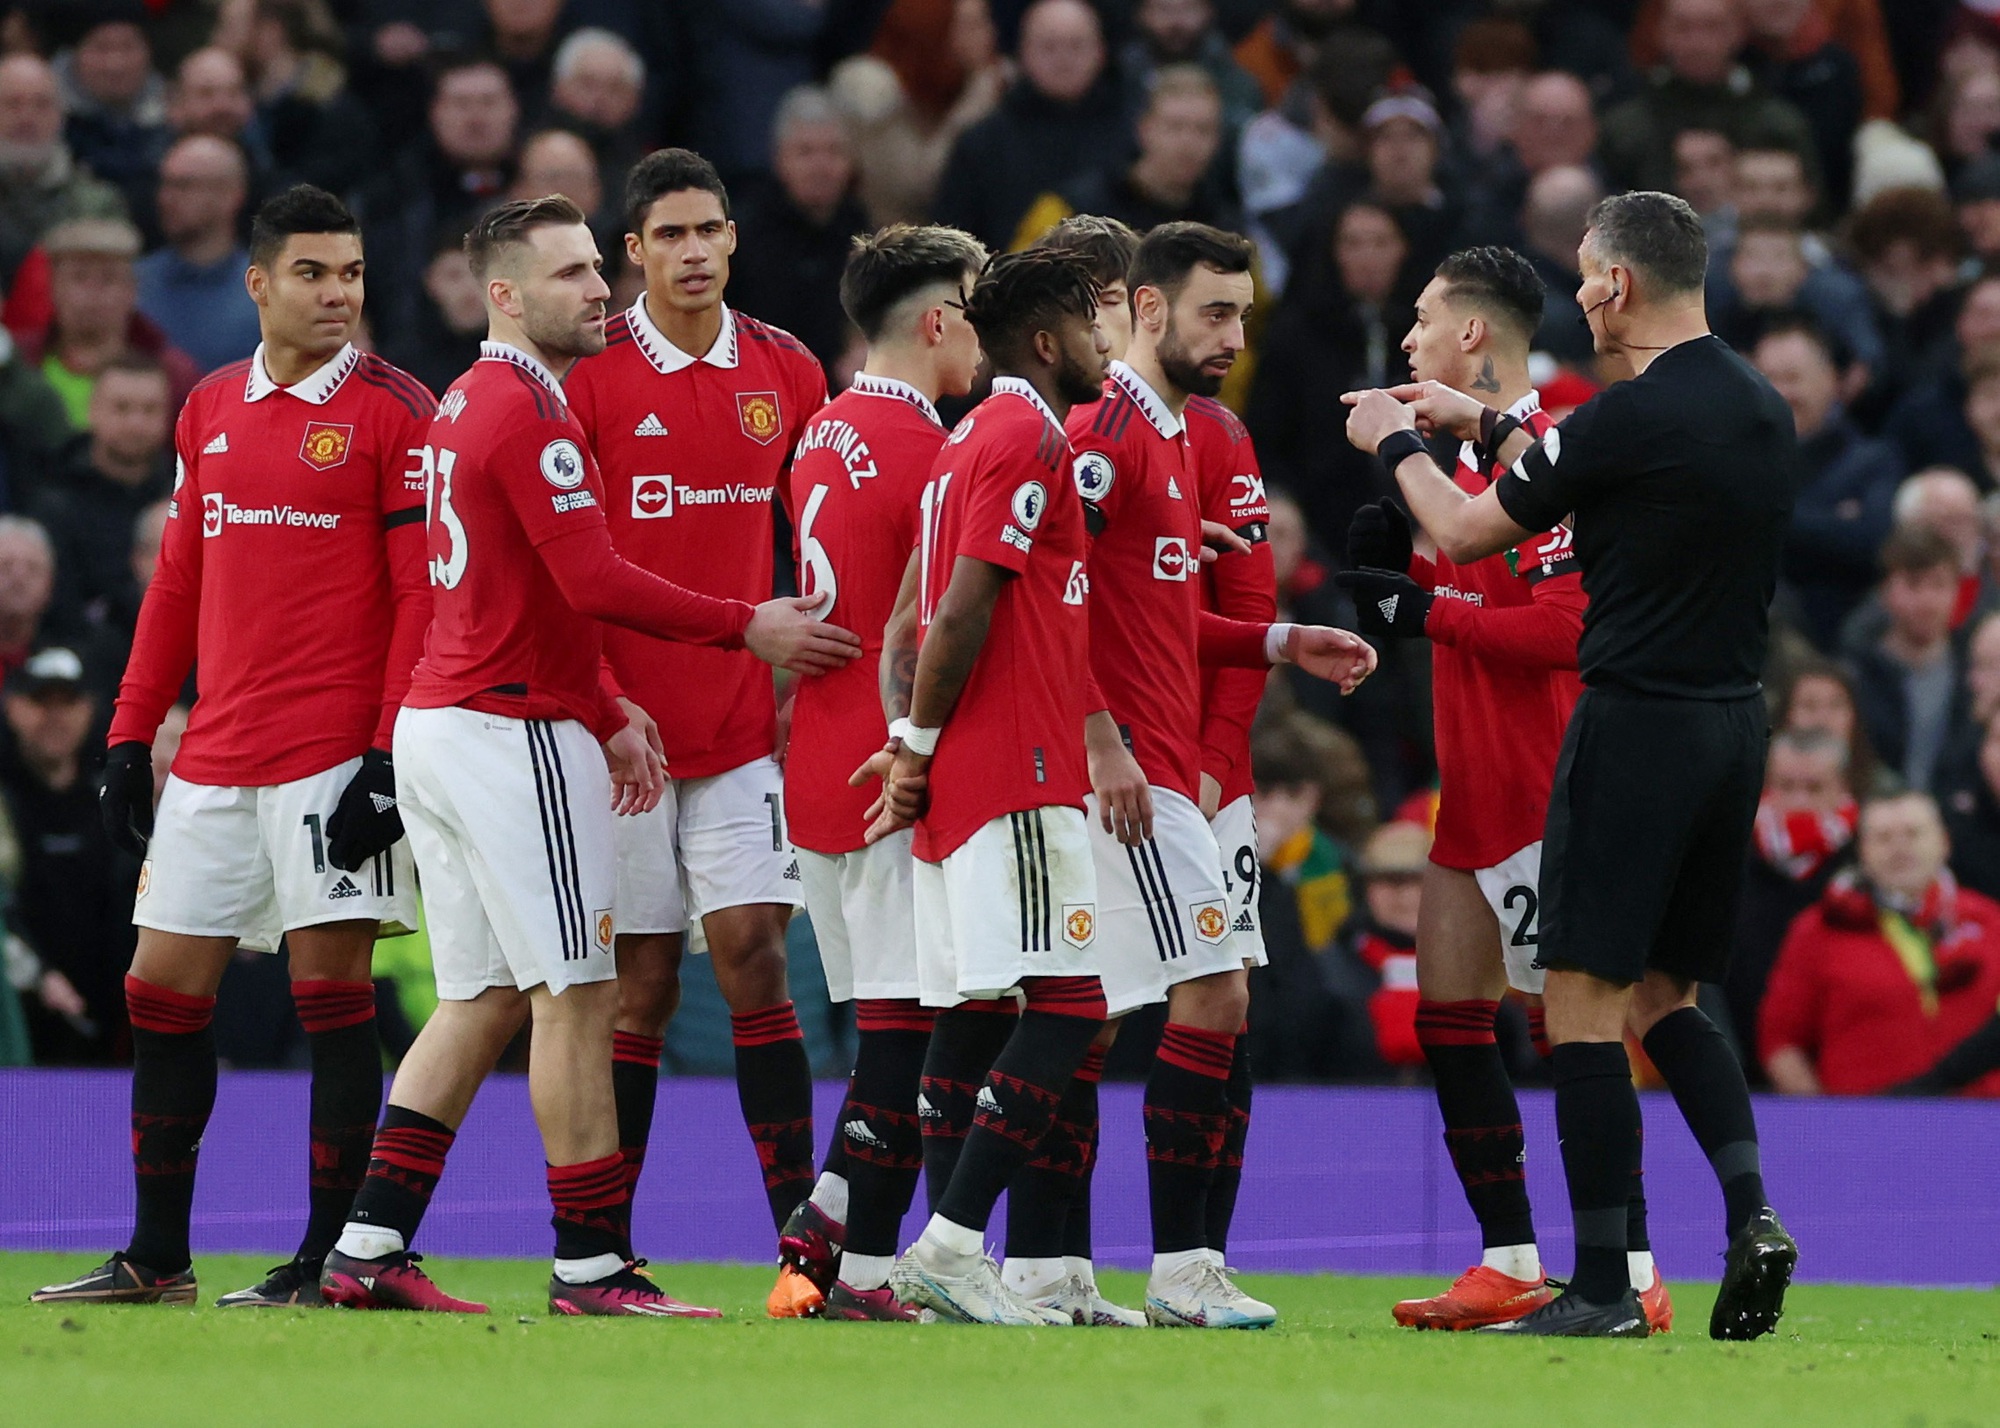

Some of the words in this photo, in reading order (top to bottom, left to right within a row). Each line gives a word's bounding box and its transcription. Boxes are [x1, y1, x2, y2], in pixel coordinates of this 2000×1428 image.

[635, 427, 668, 436] adidas
[674, 483, 774, 505] TeamViewe
[223, 503, 341, 529] TeamViewer
[801, 483, 837, 622] 6
[1540, 551, 1575, 565] TECHN
[303, 813, 325, 873] 1
[764, 793, 782, 852] 1
[328, 888, 362, 900] adidas
[1222, 845, 1256, 905] 9
[1503, 885, 1538, 946] 2
